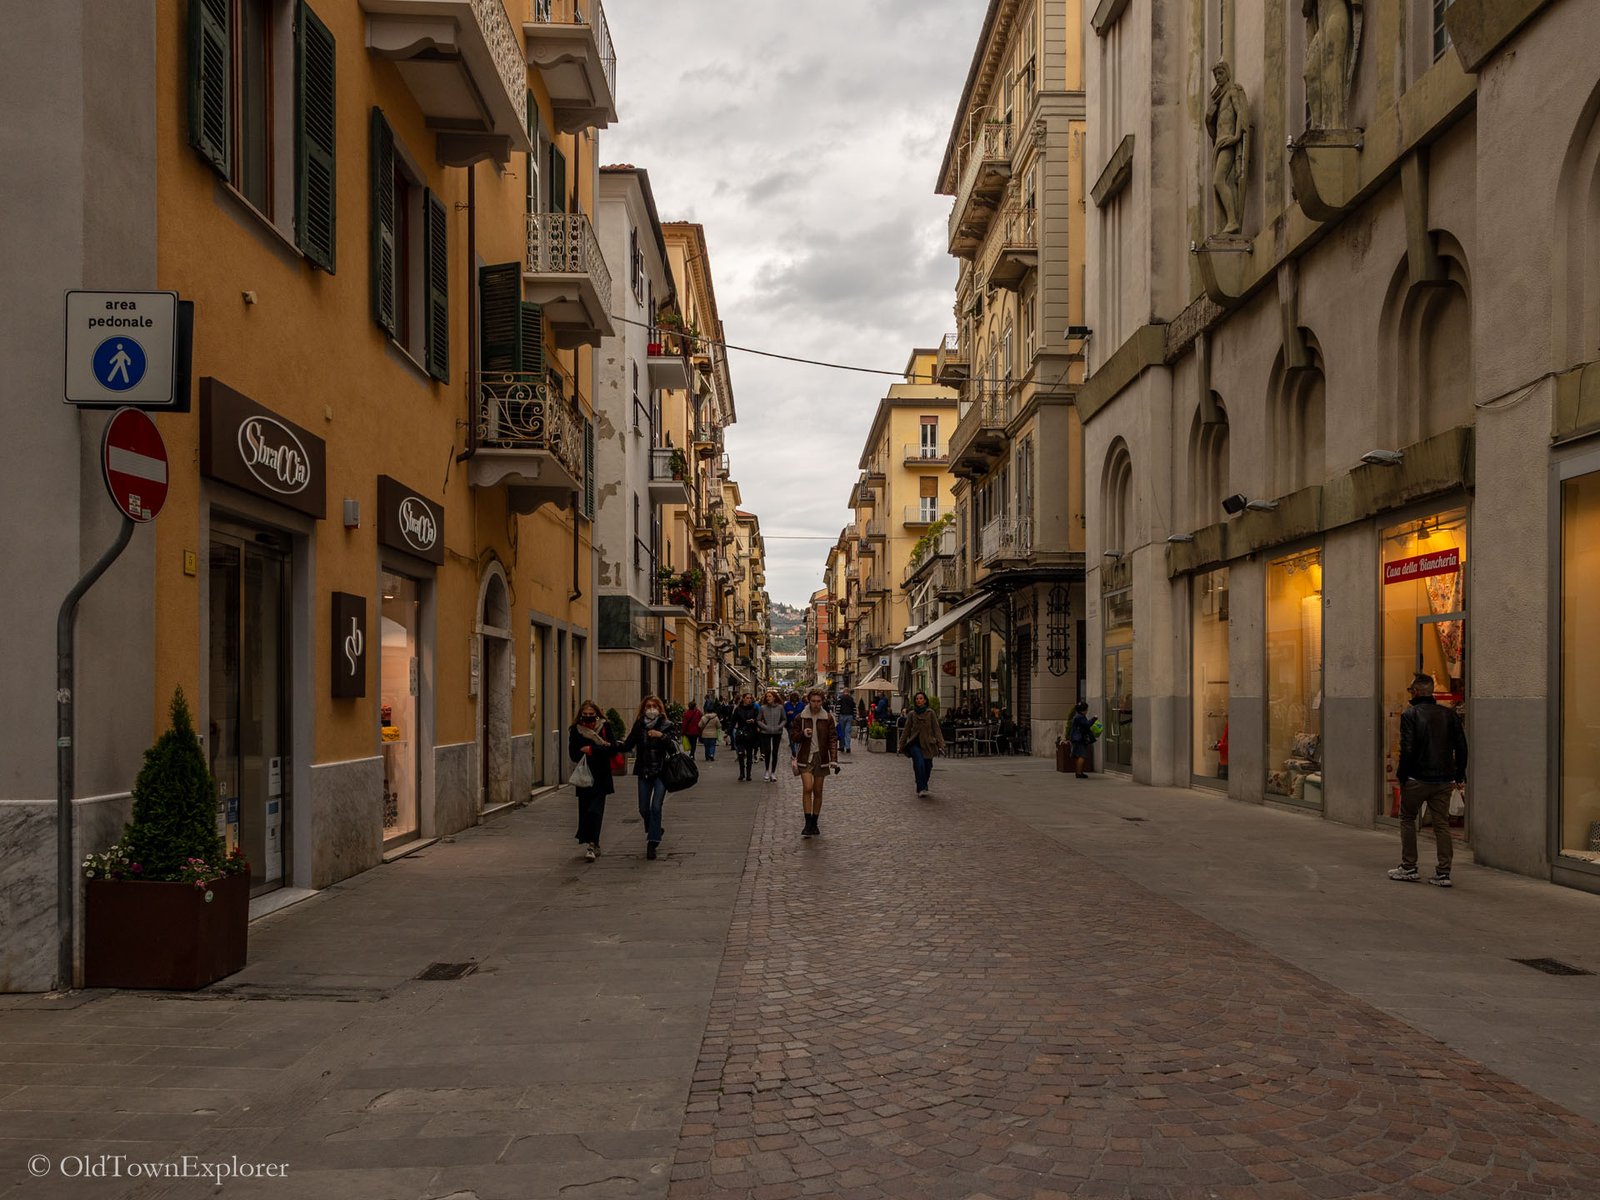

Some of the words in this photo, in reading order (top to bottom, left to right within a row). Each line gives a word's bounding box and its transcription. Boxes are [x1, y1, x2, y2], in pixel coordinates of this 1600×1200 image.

[105, 301, 136, 310] area
[88, 315, 153, 329] pedonale
[1386, 565, 1401, 578] Casa
[1401, 561, 1418, 575] della
[1419, 553, 1457, 572] Biancheria
